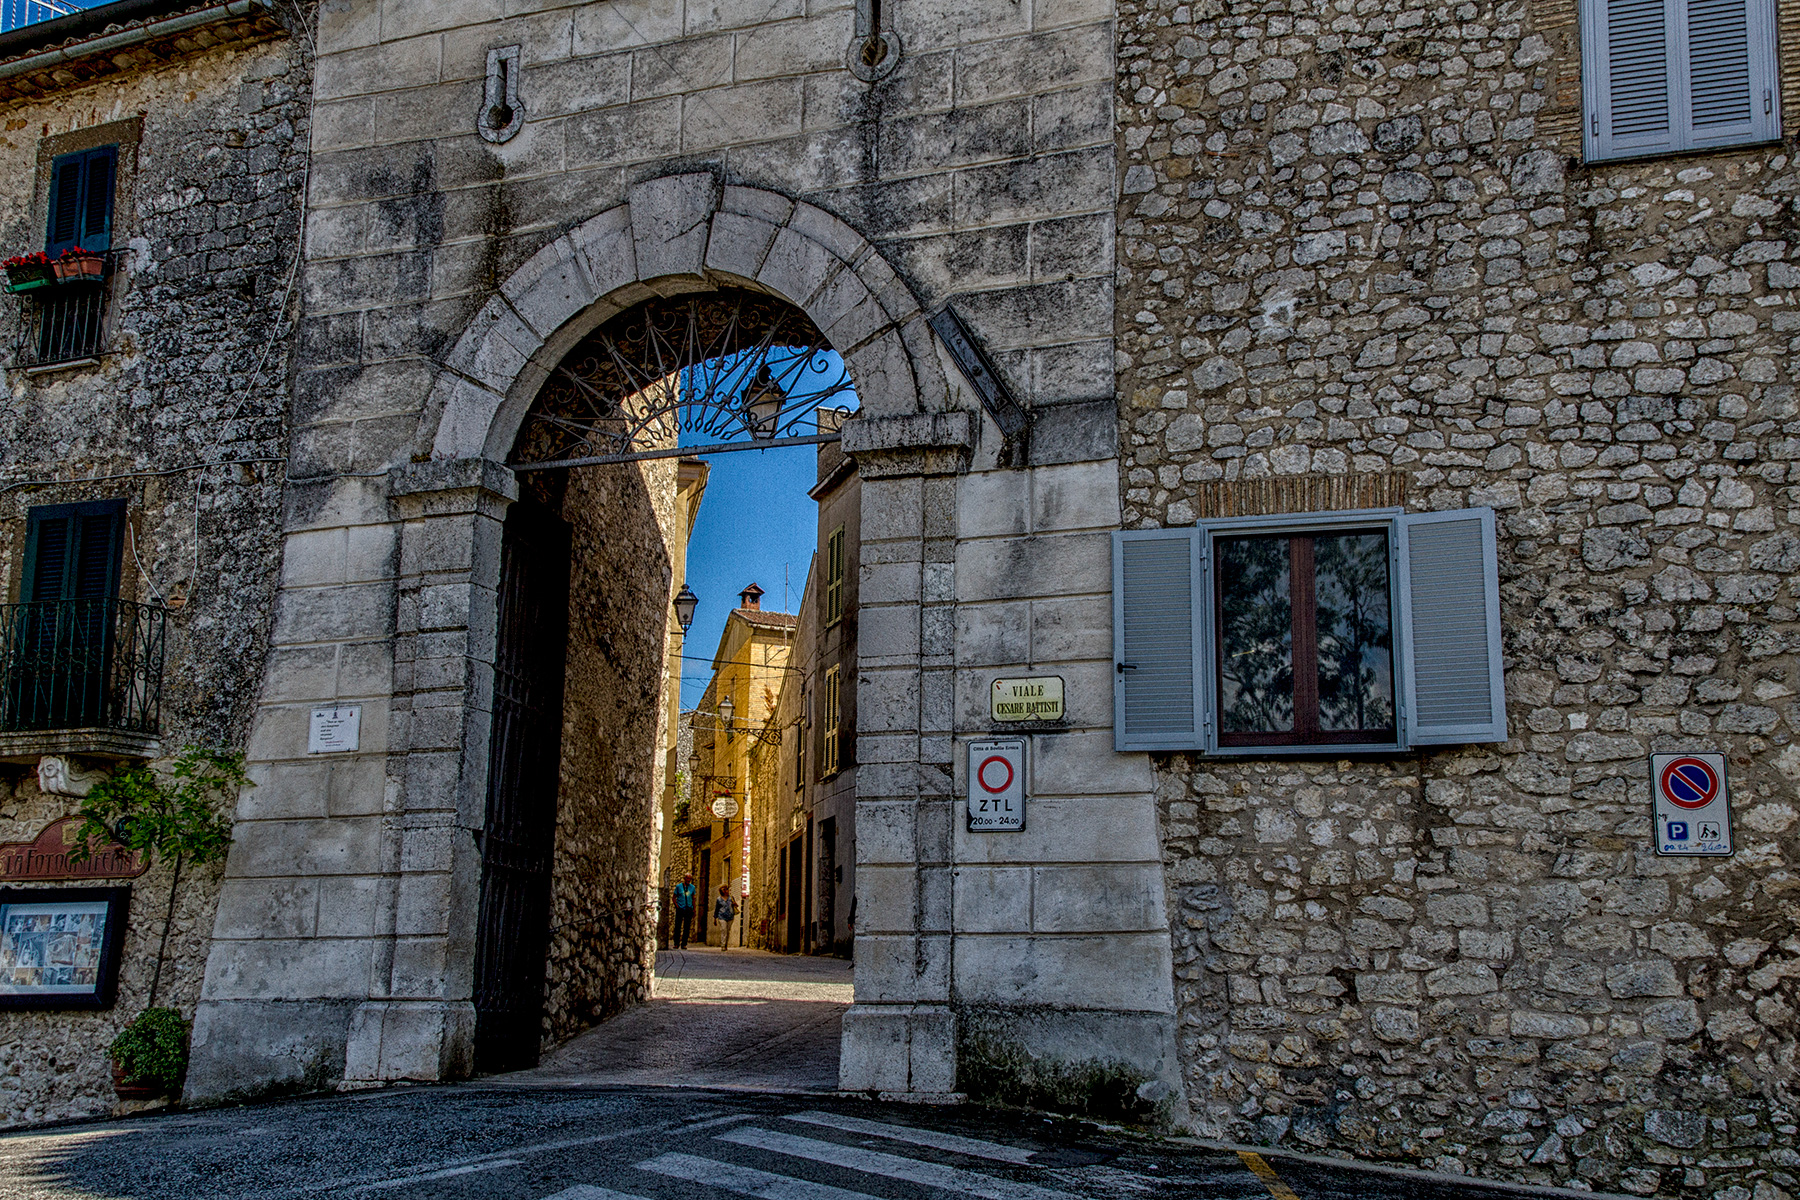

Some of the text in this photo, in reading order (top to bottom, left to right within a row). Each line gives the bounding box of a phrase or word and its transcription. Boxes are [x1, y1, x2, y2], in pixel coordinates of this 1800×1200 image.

[1012, 685, 1044, 697] VIALE
[996, 701, 1059, 715] CESARE BATTISTI
[979, 799, 1013, 812] ZTL
[973, 817, 993, 825] 20.00
[999, 816, 1019, 825] 24.00
[1671, 824, 1684, 838] P
[6, 855, 23, 875] LA
